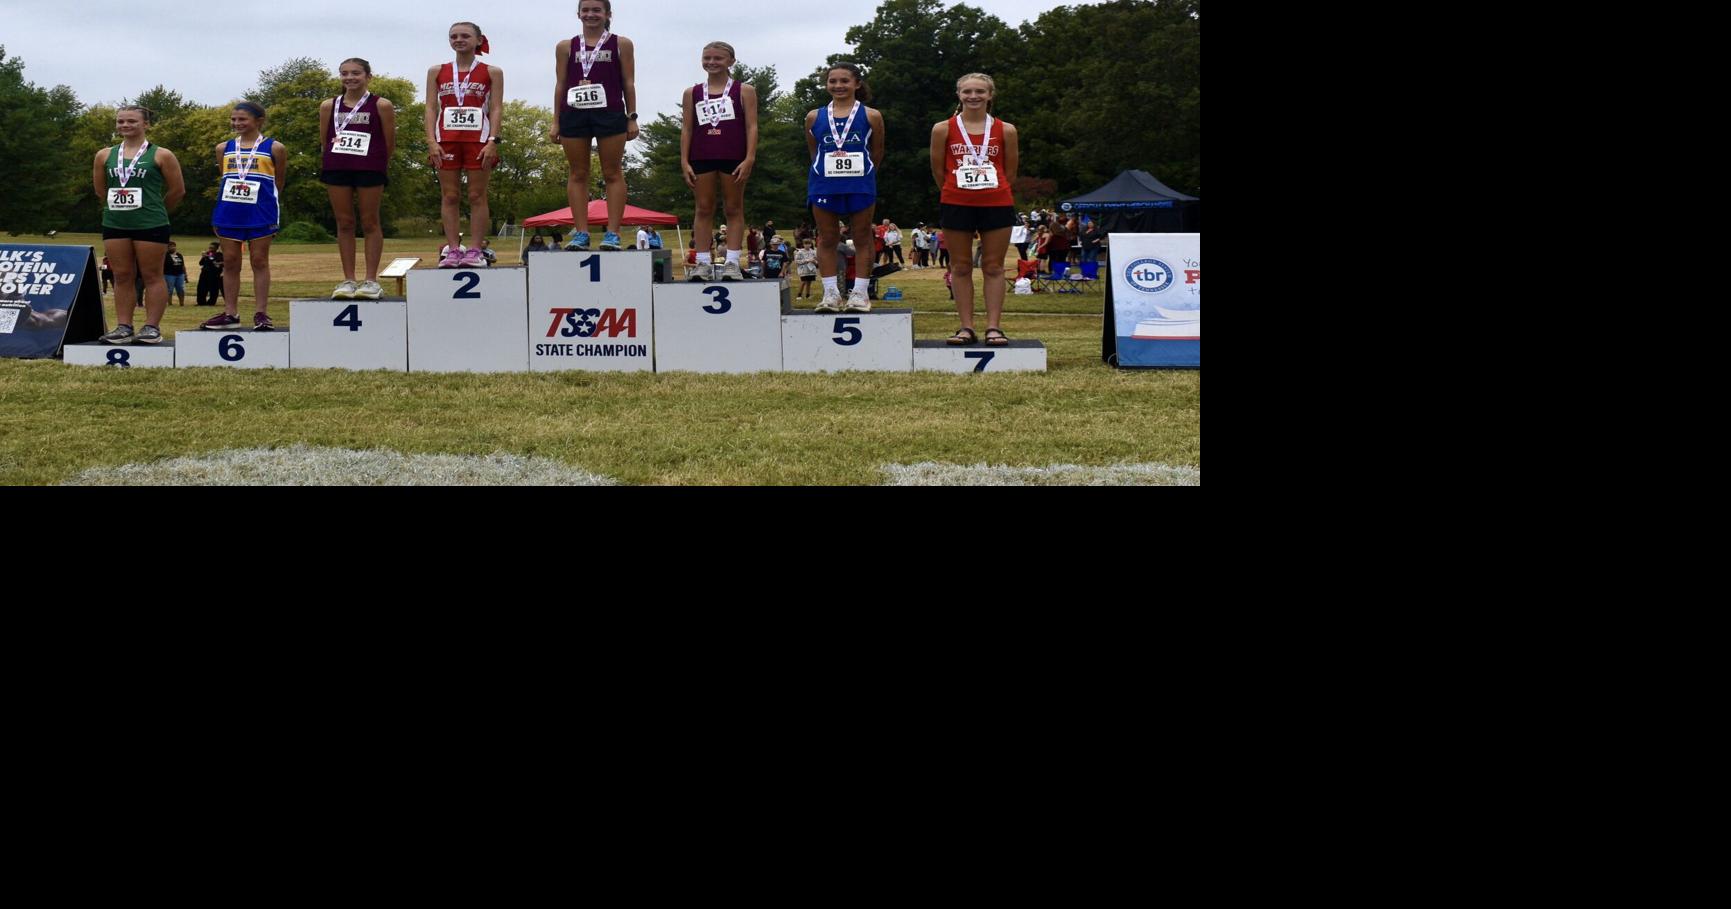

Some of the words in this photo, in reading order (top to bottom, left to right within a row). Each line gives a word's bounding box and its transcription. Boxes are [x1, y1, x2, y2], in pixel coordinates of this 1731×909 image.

[440, 82, 486, 91] MCWEN
[575, 91, 598, 103] 516
[451, 112, 475, 124] 354
[340, 136, 362, 148] 514
[823, 133, 861, 144] CA
[951, 143, 999, 156] WARRIRS
[835, 158, 852, 170] 89
[965, 172, 990, 183] 571
[229, 185, 251, 197] 419
[113, 194, 135, 204] 203
[0, 250, 44, 262] LK'S
[579, 254, 600, 282] 1
[1183, 258, 1200, 268] Yo
[33, 273, 76, 285] YOU
[1133, 269, 1164, 281] tbr
[0, 283, 54, 295] OVER
[452, 271, 481, 299] 2
[702, 286, 732, 314] 3
[333, 304, 362, 331] 4
[545, 307, 637, 337] TSSAA
[832, 317, 863, 346] 5
[218, 334, 245, 361] 6
[535, 343, 573, 356] STATE
[576, 344, 647, 357] CHAMPION
[106, 348, 131, 367] 8
[964, 351, 995, 372] 7
